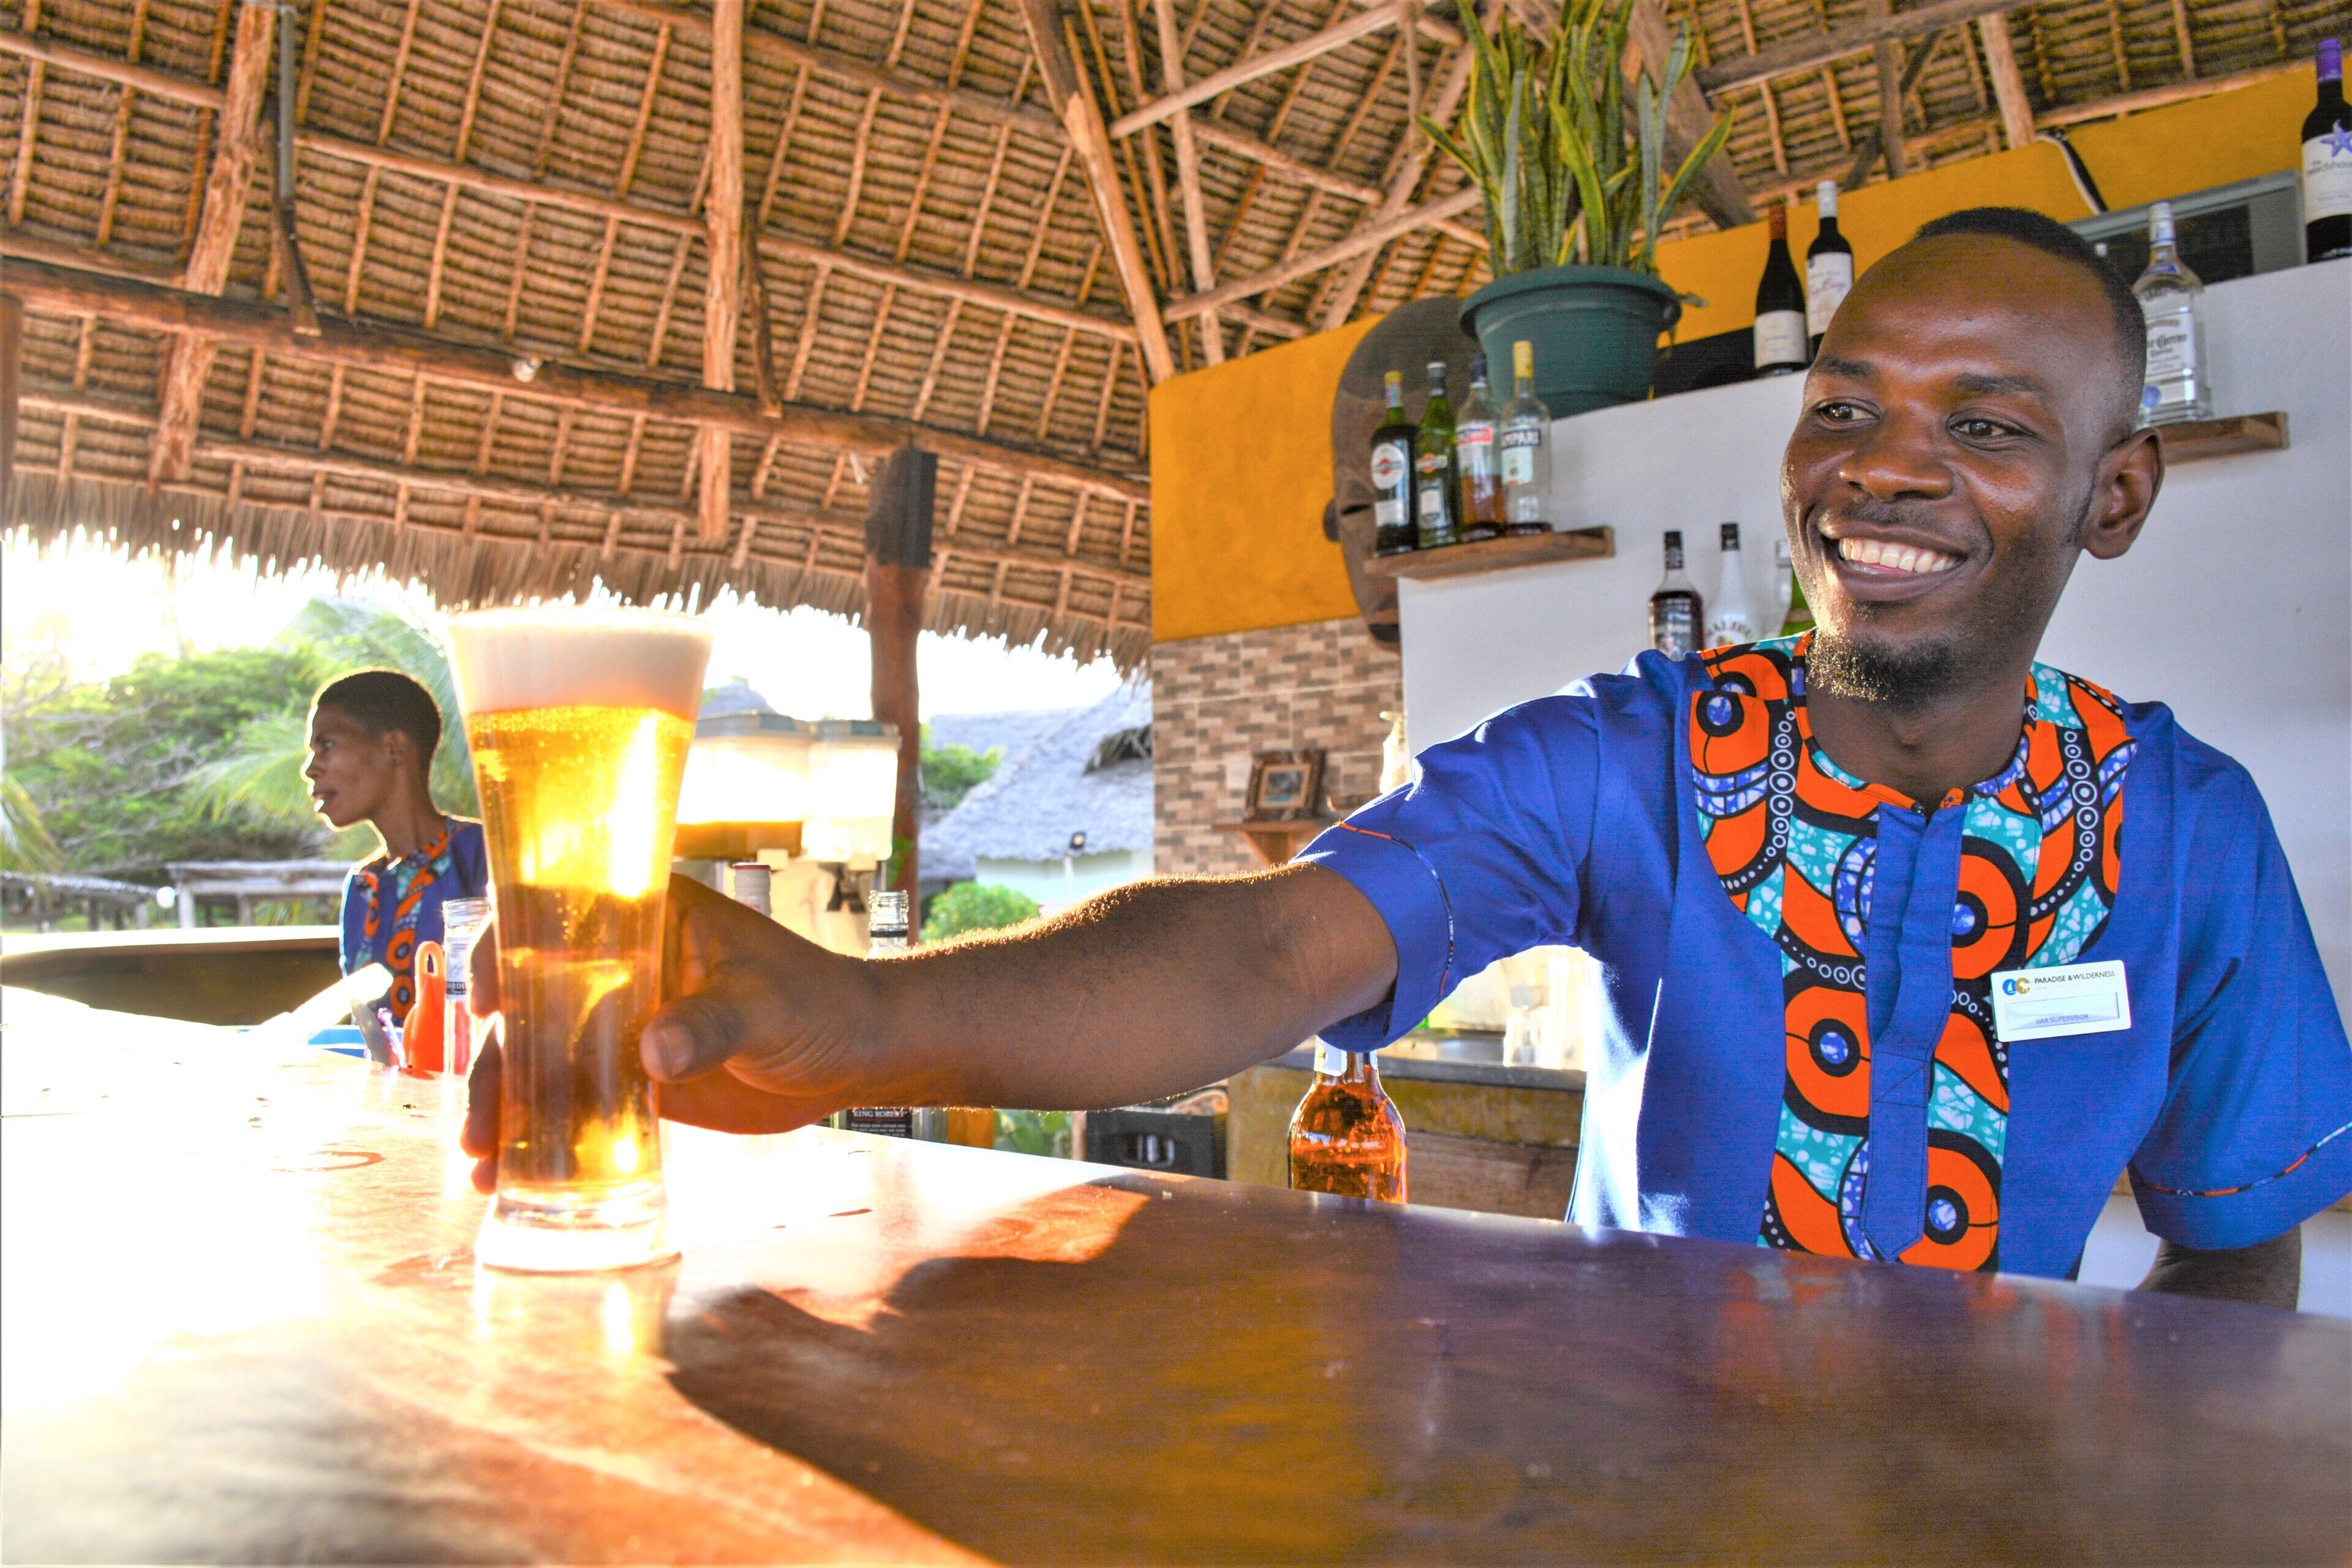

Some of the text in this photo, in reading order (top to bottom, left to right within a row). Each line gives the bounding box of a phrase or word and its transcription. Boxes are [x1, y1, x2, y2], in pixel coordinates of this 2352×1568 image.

[2034, 975, 2066, 984] PARADISE
[2073, 970, 2115, 980] WILDERNESS
[2050, 1014, 2089, 1023] SUPERVISOR
